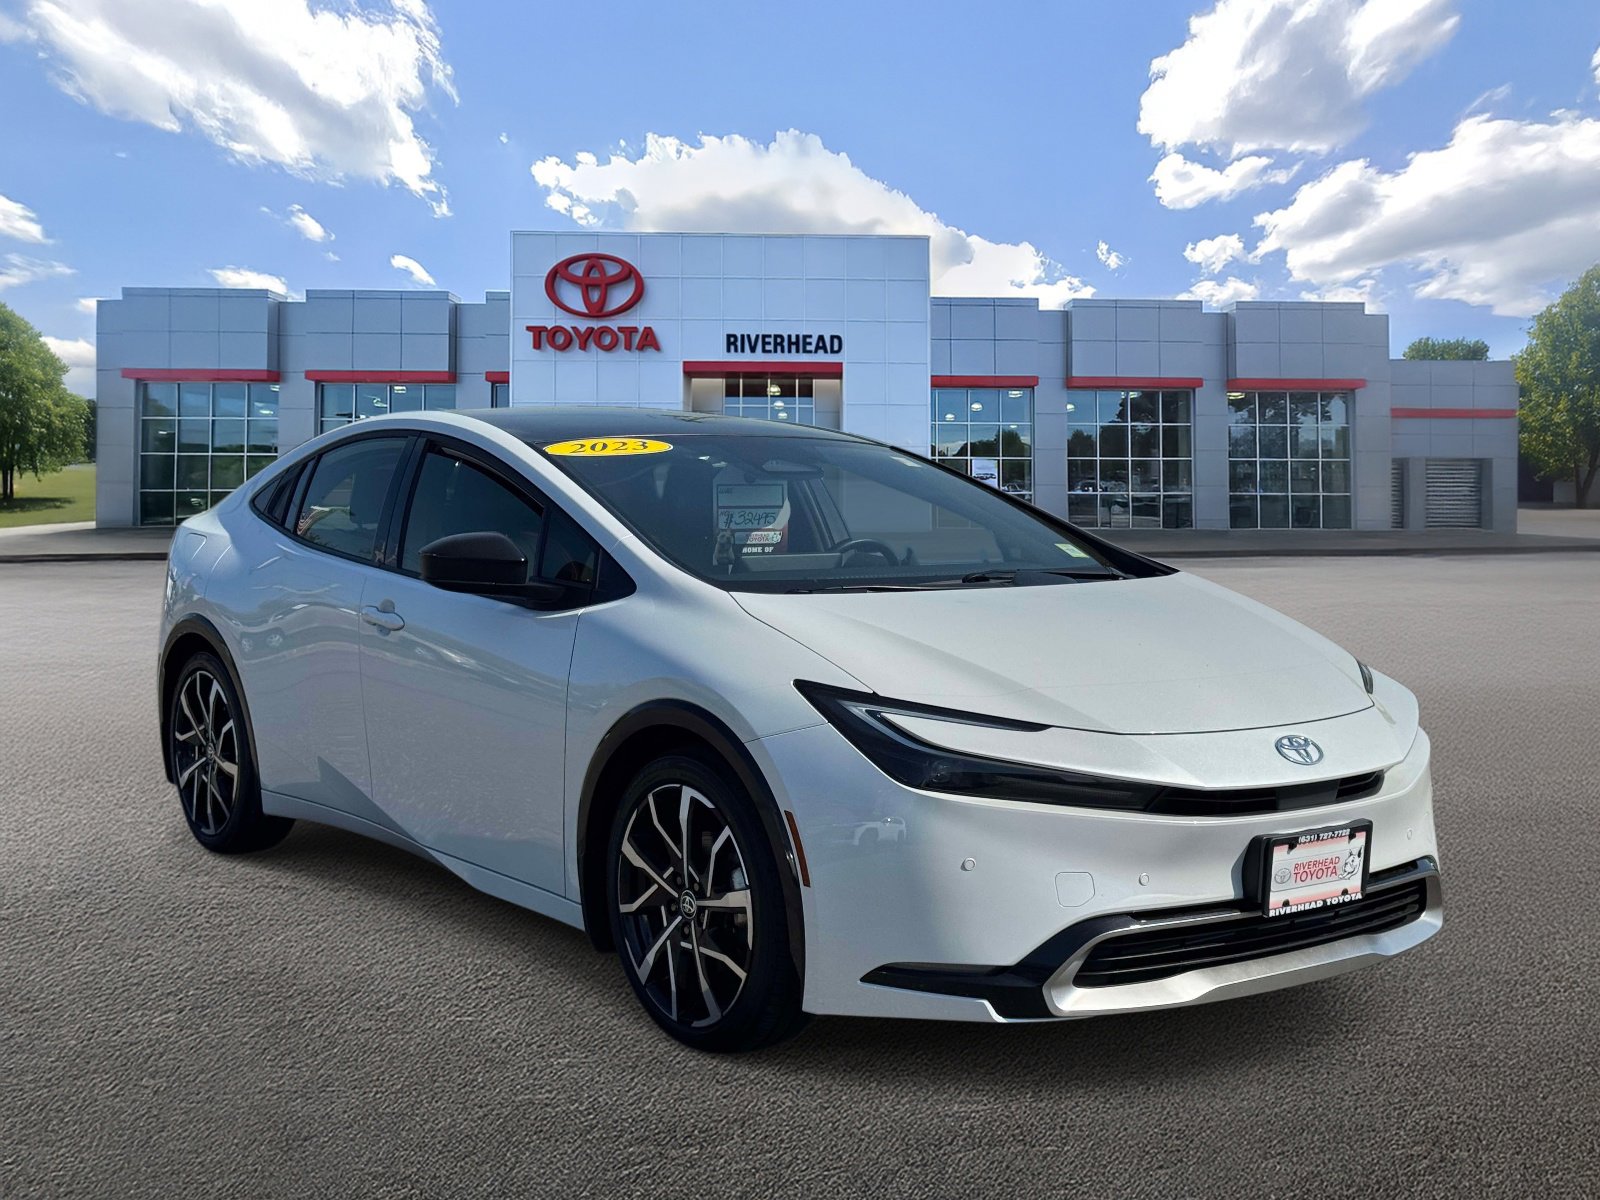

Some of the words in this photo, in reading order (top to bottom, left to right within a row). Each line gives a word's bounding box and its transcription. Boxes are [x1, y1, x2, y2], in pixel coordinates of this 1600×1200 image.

[526, 325, 662, 353] TOYOTA
[725, 333, 843, 355] RIVERHEAD
[570, 441, 649, 453] 2023
[1298, 834, 1318, 844] (631)
[1293, 856, 1341, 873] RIVERHEAD
[1293, 865, 1338, 884] TOYOTA
[1269, 899, 1324, 918] RIVERHEAD
[1326, 892, 1363, 906] TOYOTA
